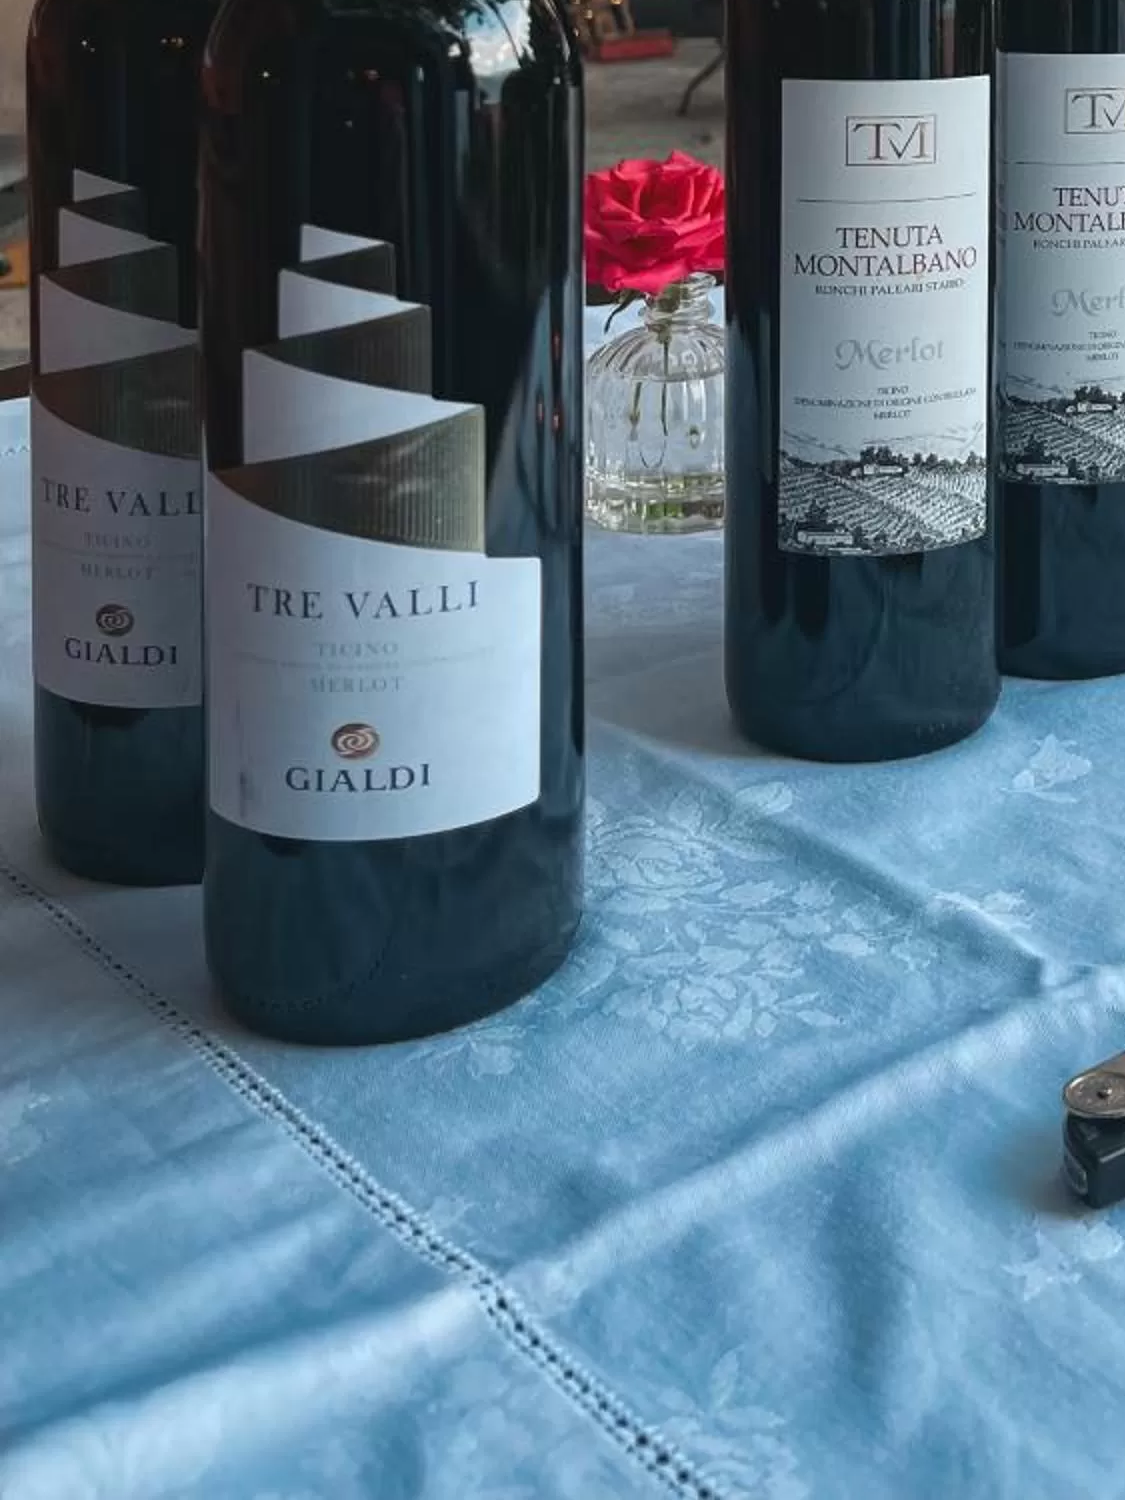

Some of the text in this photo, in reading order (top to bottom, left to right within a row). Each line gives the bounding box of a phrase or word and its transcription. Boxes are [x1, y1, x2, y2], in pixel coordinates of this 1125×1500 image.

[836, 225, 943, 249] TENUTA
[794, 246, 977, 277] MONTALBANO
[834, 336, 945, 370] Merlot
[41, 476, 204, 517] TRE VALL
[247, 580, 478, 619] TRE VALLI
[65, 636, 178, 667] GIALDI
[316, 642, 399, 658] TICINO
[310, 675, 404, 693] MERLOT
[285, 763, 431, 794] GIALDI
